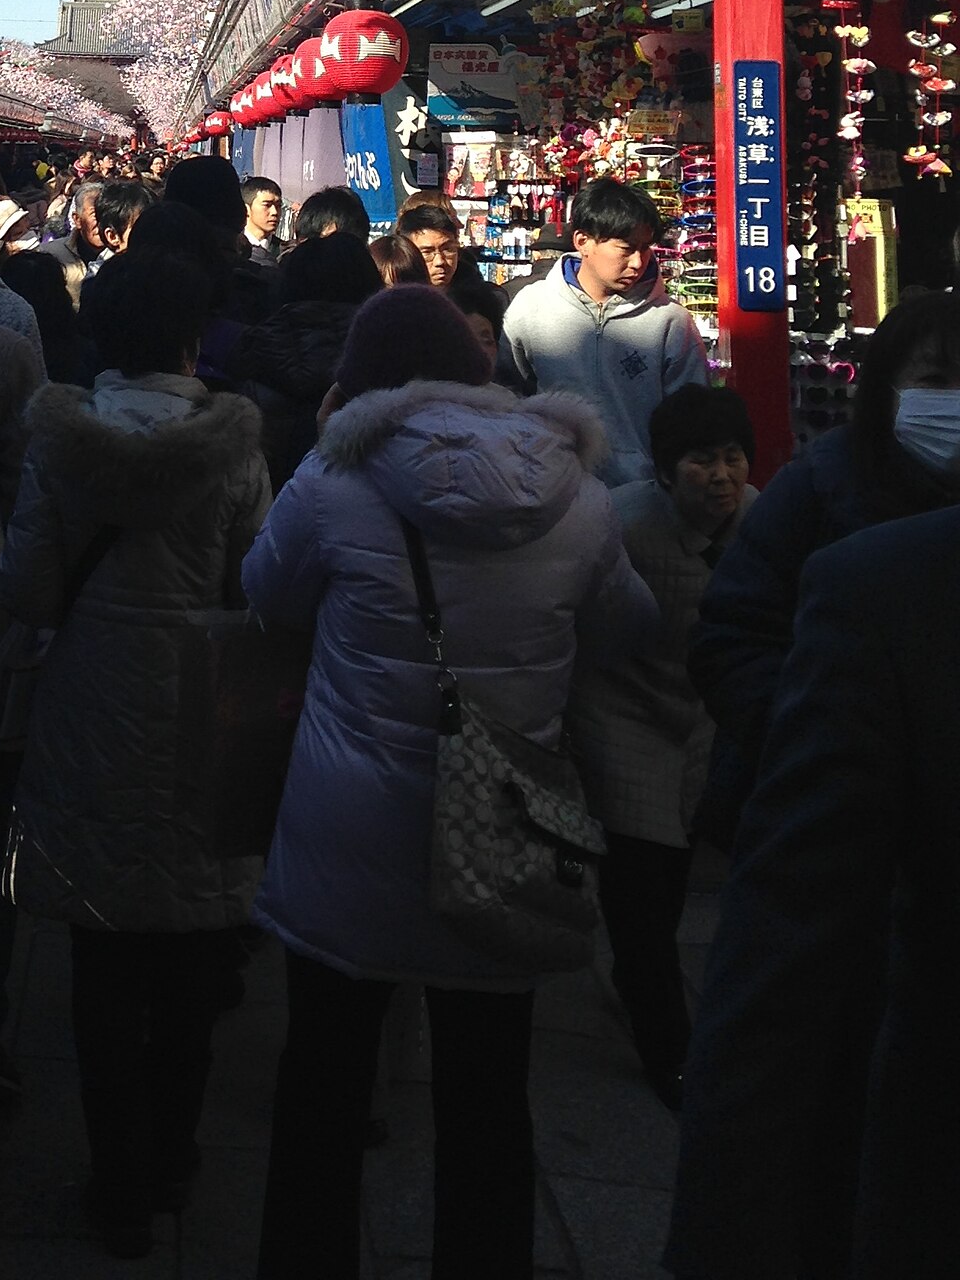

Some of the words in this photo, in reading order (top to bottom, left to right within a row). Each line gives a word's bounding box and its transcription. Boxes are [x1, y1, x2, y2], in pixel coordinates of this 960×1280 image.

[738, 77, 747, 101] TAITO
[752, 77, 763, 109] 台東区
[738, 103, 747, 122] CITY
[745, 267, 775, 293] 18
